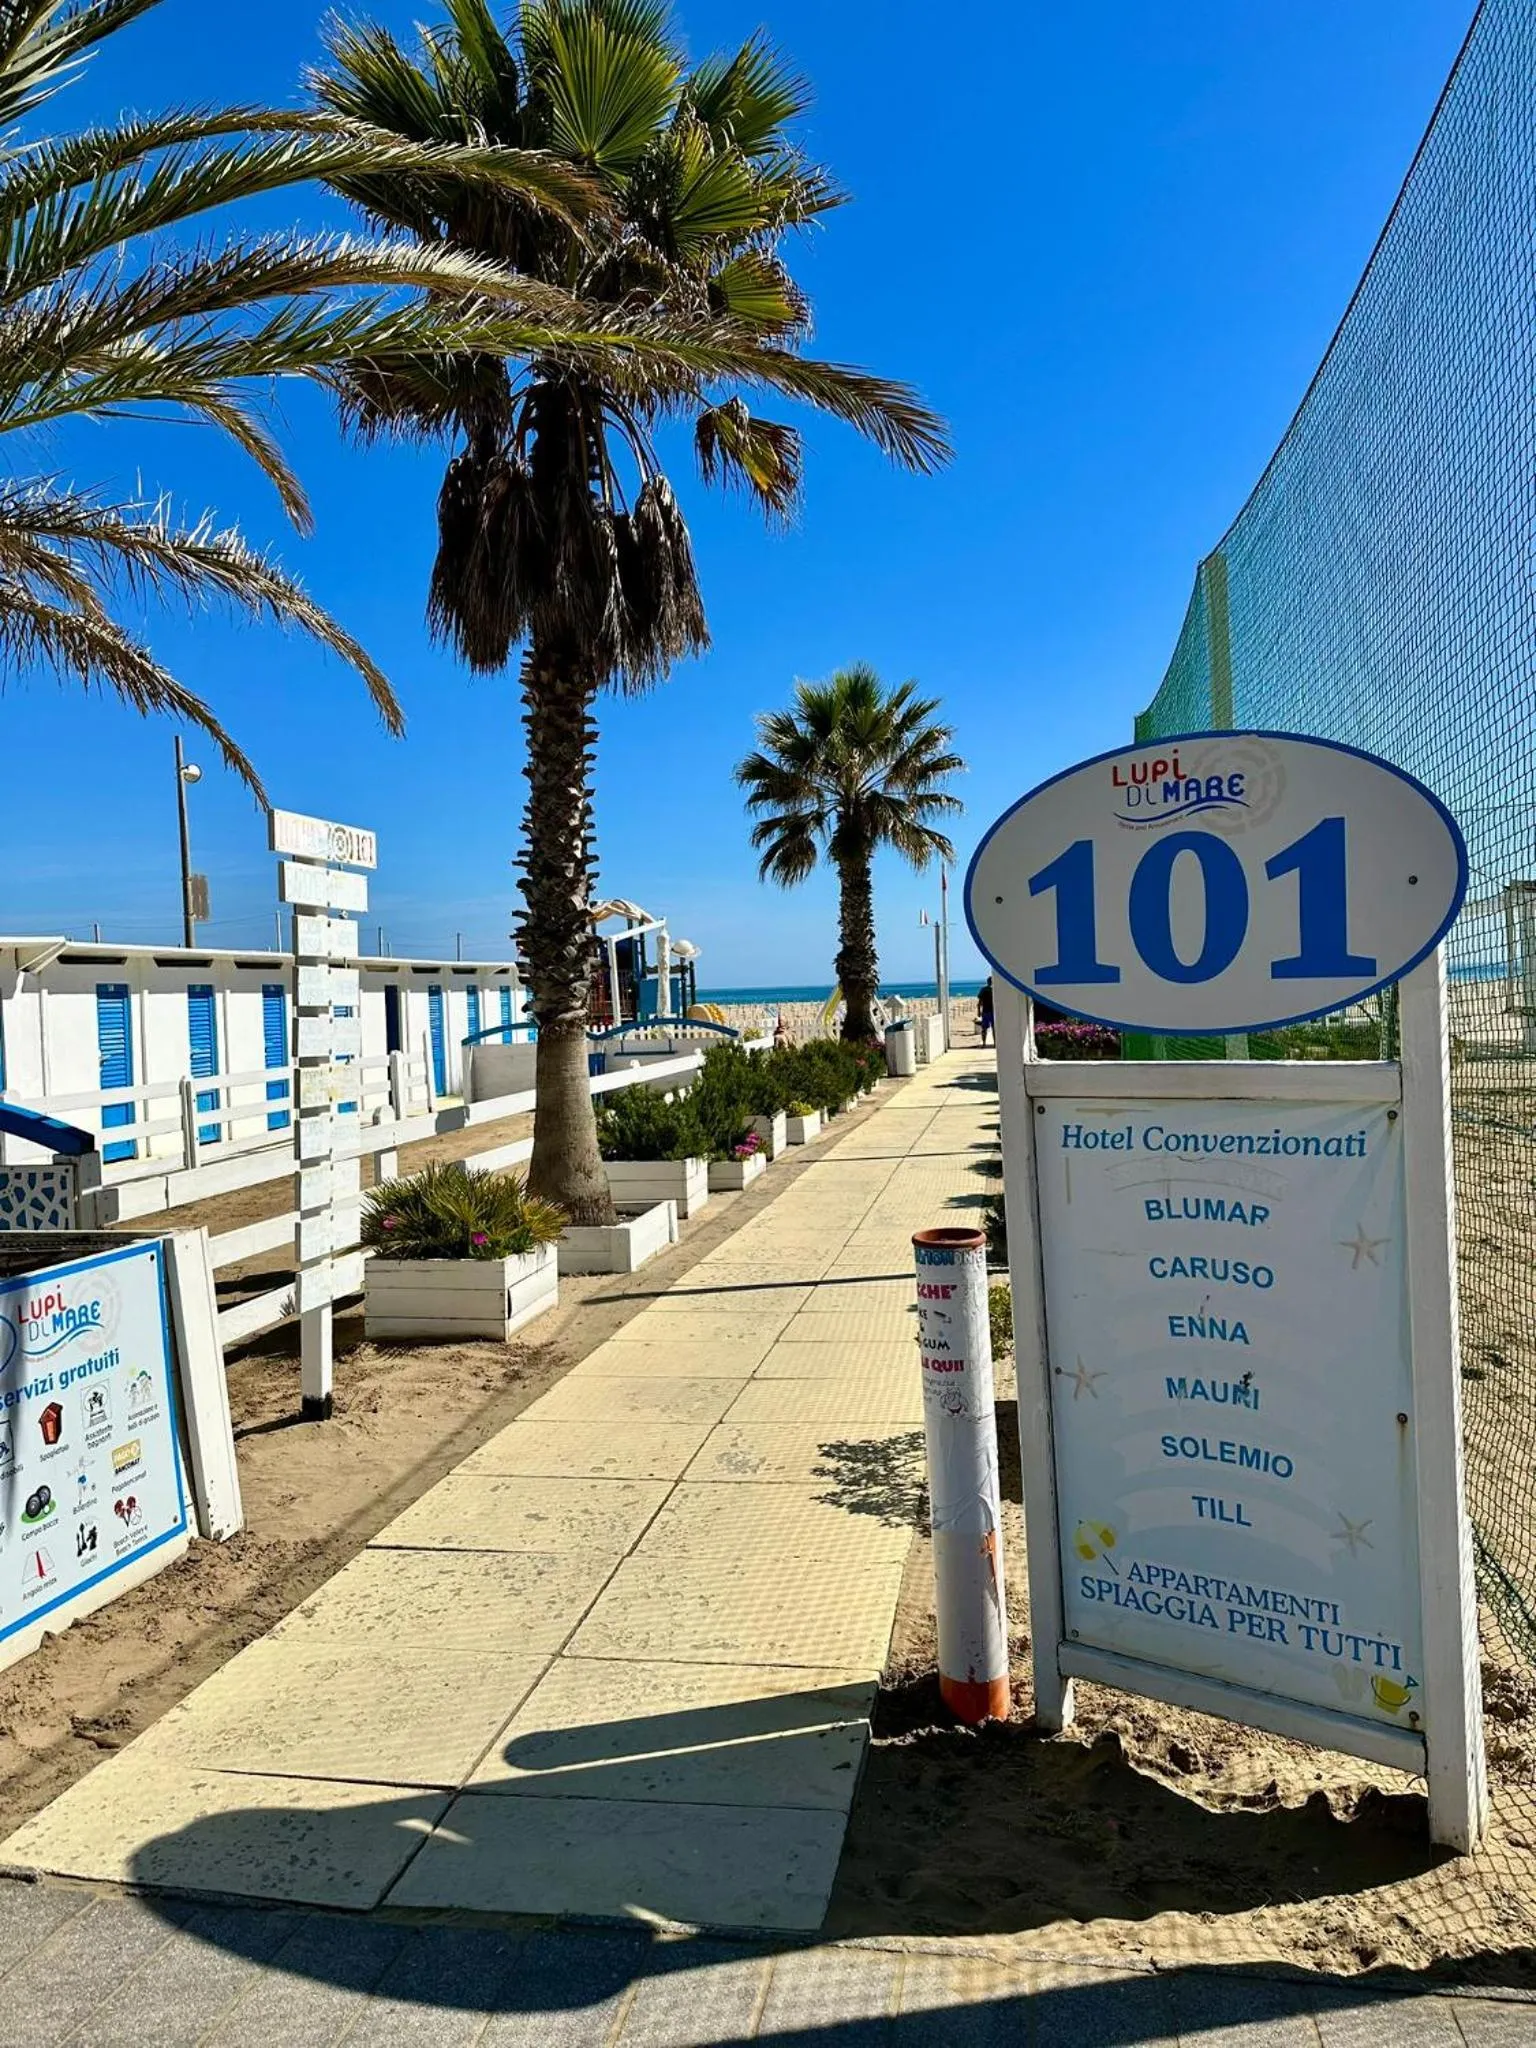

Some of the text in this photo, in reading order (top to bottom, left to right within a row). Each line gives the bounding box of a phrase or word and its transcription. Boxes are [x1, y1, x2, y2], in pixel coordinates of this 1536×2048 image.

[1162, 773, 1246, 803] MARE
[1028, 816, 1377, 984] 101
[1061, 1125, 1368, 1158] Hotel Convenzionati
[1145, 1198, 1270, 1226] BLUMAR
[1149, 1257, 1274, 1289] CARUSO
[52, 1301, 100, 1333] MARE
[1168, 1316, 1250, 1345] ENNA
[58, 1347, 120, 1390] gratuiti
[1165, 1376, 1259, 1411] MAURI
[1161, 1435, 1293, 1479] SOLEMIO
[1192, 1496, 1252, 1526] TILL
[1127, 1561, 1340, 1626] APPARTAMENTI
[1080, 1576, 1403, 1671] SPIAGGIA PER TUTTI
